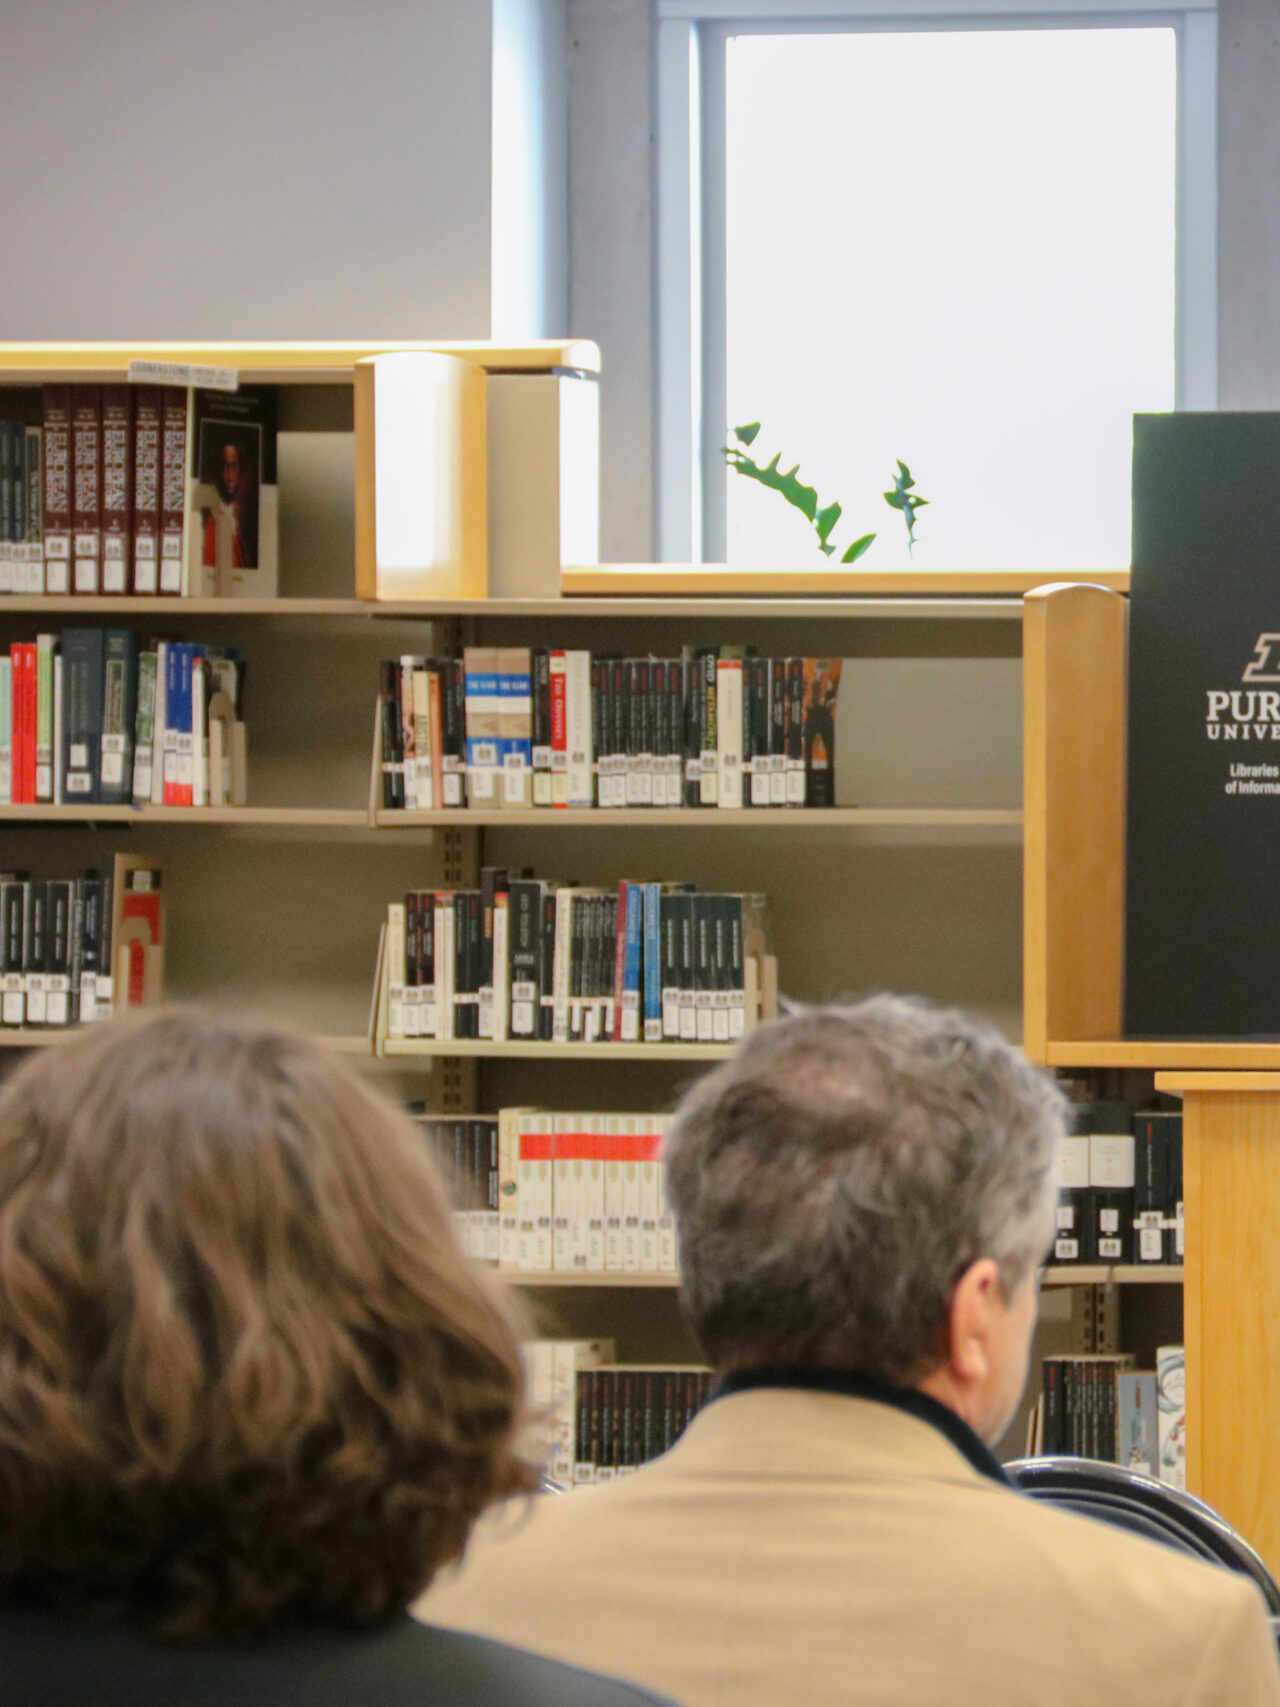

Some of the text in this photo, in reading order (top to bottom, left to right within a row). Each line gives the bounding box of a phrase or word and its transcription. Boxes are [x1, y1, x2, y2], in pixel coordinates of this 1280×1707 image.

[707, 654, 715, 682] OVID
[1229, 763, 1280, 779] Libraries
[1224, 779, 1237, 795] of
